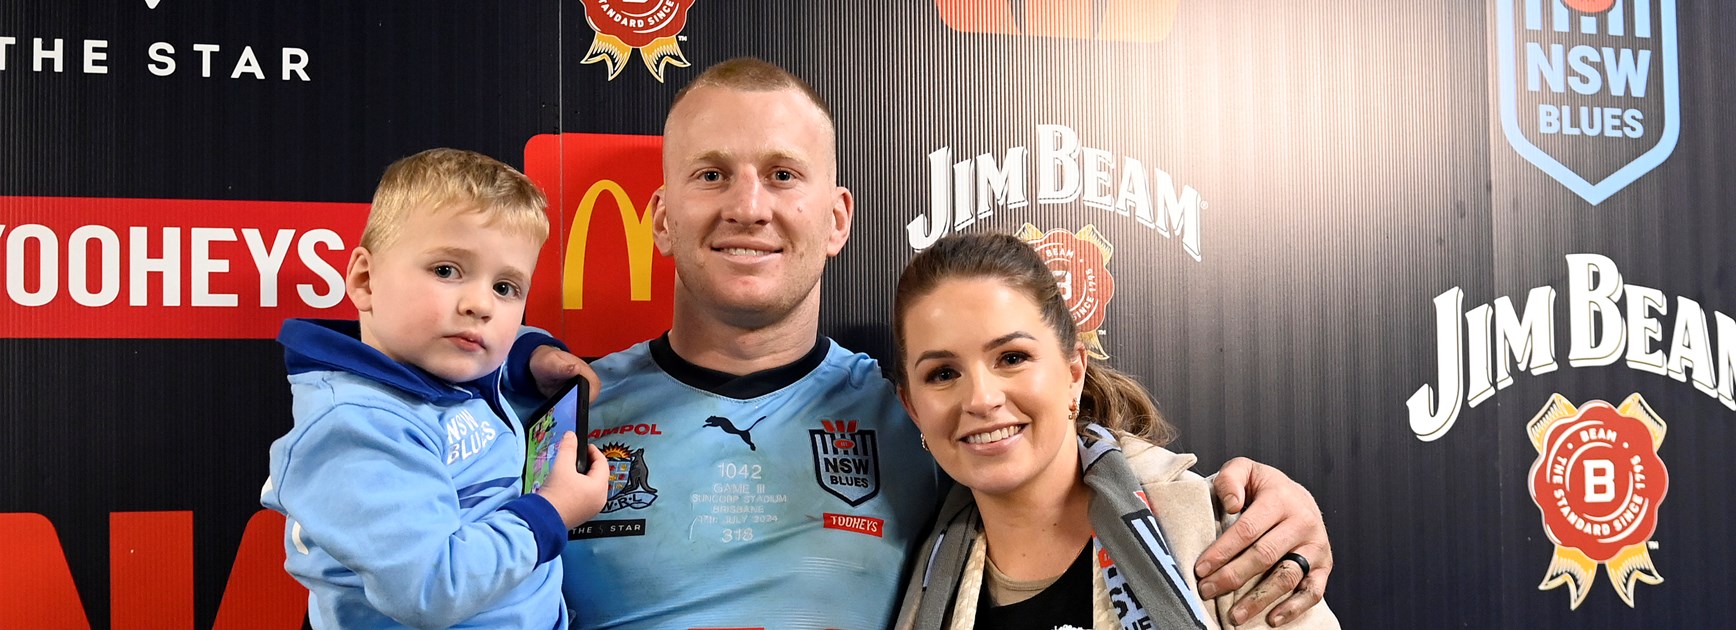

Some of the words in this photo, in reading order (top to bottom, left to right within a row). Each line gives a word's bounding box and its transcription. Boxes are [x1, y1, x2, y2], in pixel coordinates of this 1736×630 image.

[648, 0, 674, 26] SINCE
[0, 37, 108, 73] THE
[148, 42, 311, 81] STAR
[1526, 42, 1651, 97] NSW
[1539, 104, 1644, 138] BLUES
[906, 146, 1028, 252] JIM
[1038, 124, 1202, 262] BEAM
[1045, 248, 1074, 258] BEAM
[0, 223, 345, 309] OOHEYS
[1085, 268, 1097, 292] 1795
[1406, 285, 1558, 442] JIM
[446, 409, 479, 445] NSW
[587, 423, 662, 438] AMPOL
[1580, 428, 1617, 442] BEAM
[718, 462, 762, 480] 1042
[824, 457, 869, 475] NSW
[1552, 456, 1568, 484] THE
[1630, 455, 1646, 489] 1795
[713, 483, 750, 494] GAME
[756, 483, 765, 494] III
[830, 475, 868, 488] BLUES
[1582, 459, 1615, 503] B
[691, 493, 739, 504] SUNCORP
[743, 494, 787, 504] STADIUM
[712, 505, 765, 514] BRISBANE
[725, 515, 749, 524] JULY
[753, 514, 778, 523] 2024
[830, 515, 878, 533] TOOHEYS
[1554, 489, 1611, 536] STANDARD
[1613, 495, 1644, 532] SINCE
[572, 526, 593, 535] THE
[610, 524, 641, 532] STAR
[722, 527, 754, 543] 318
